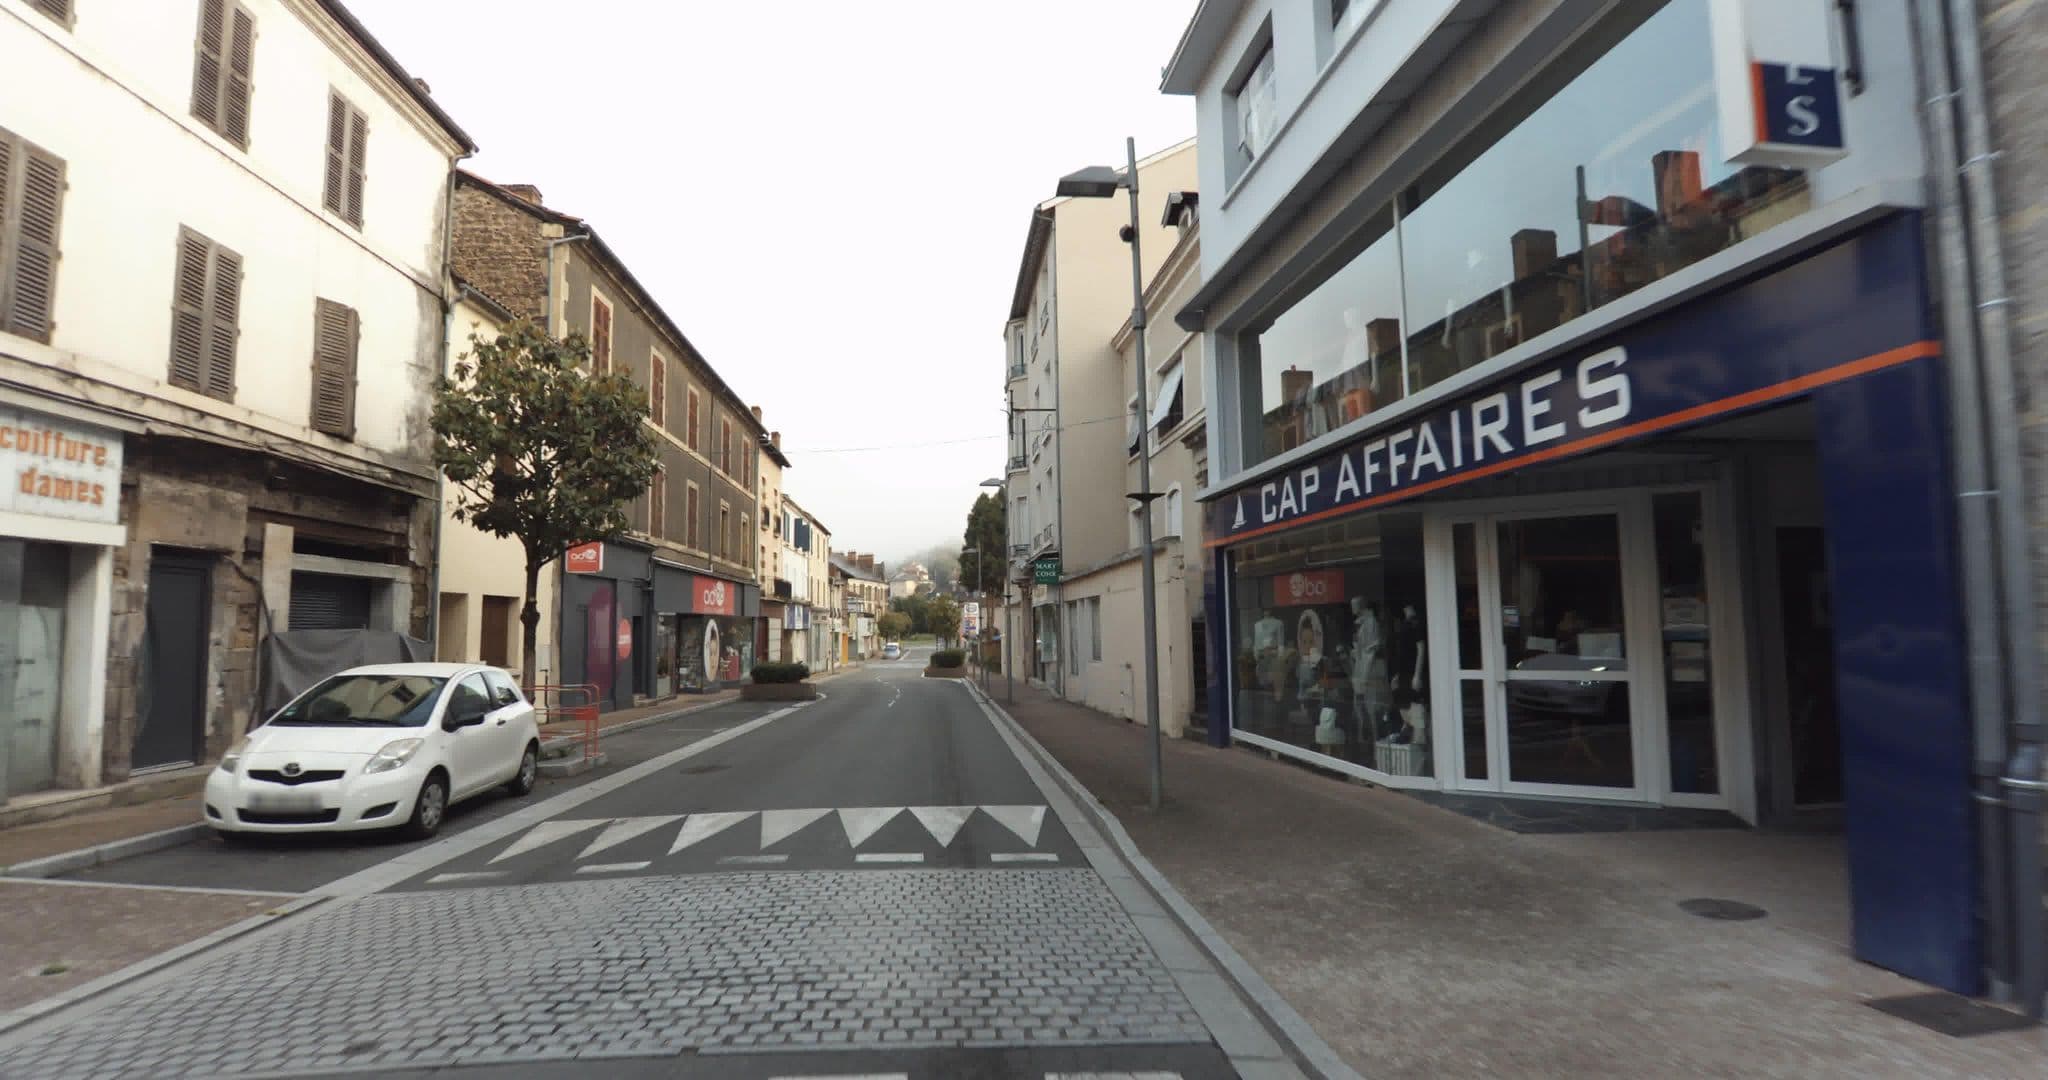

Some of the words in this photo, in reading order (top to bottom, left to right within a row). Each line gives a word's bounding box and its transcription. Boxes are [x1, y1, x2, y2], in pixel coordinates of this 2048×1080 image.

[0, 427, 107, 466] coiffure
[1262, 468, 1320, 522] CAP
[1336, 346, 1631, 502] AFFAIRES
[21, 467, 104, 505] dames
